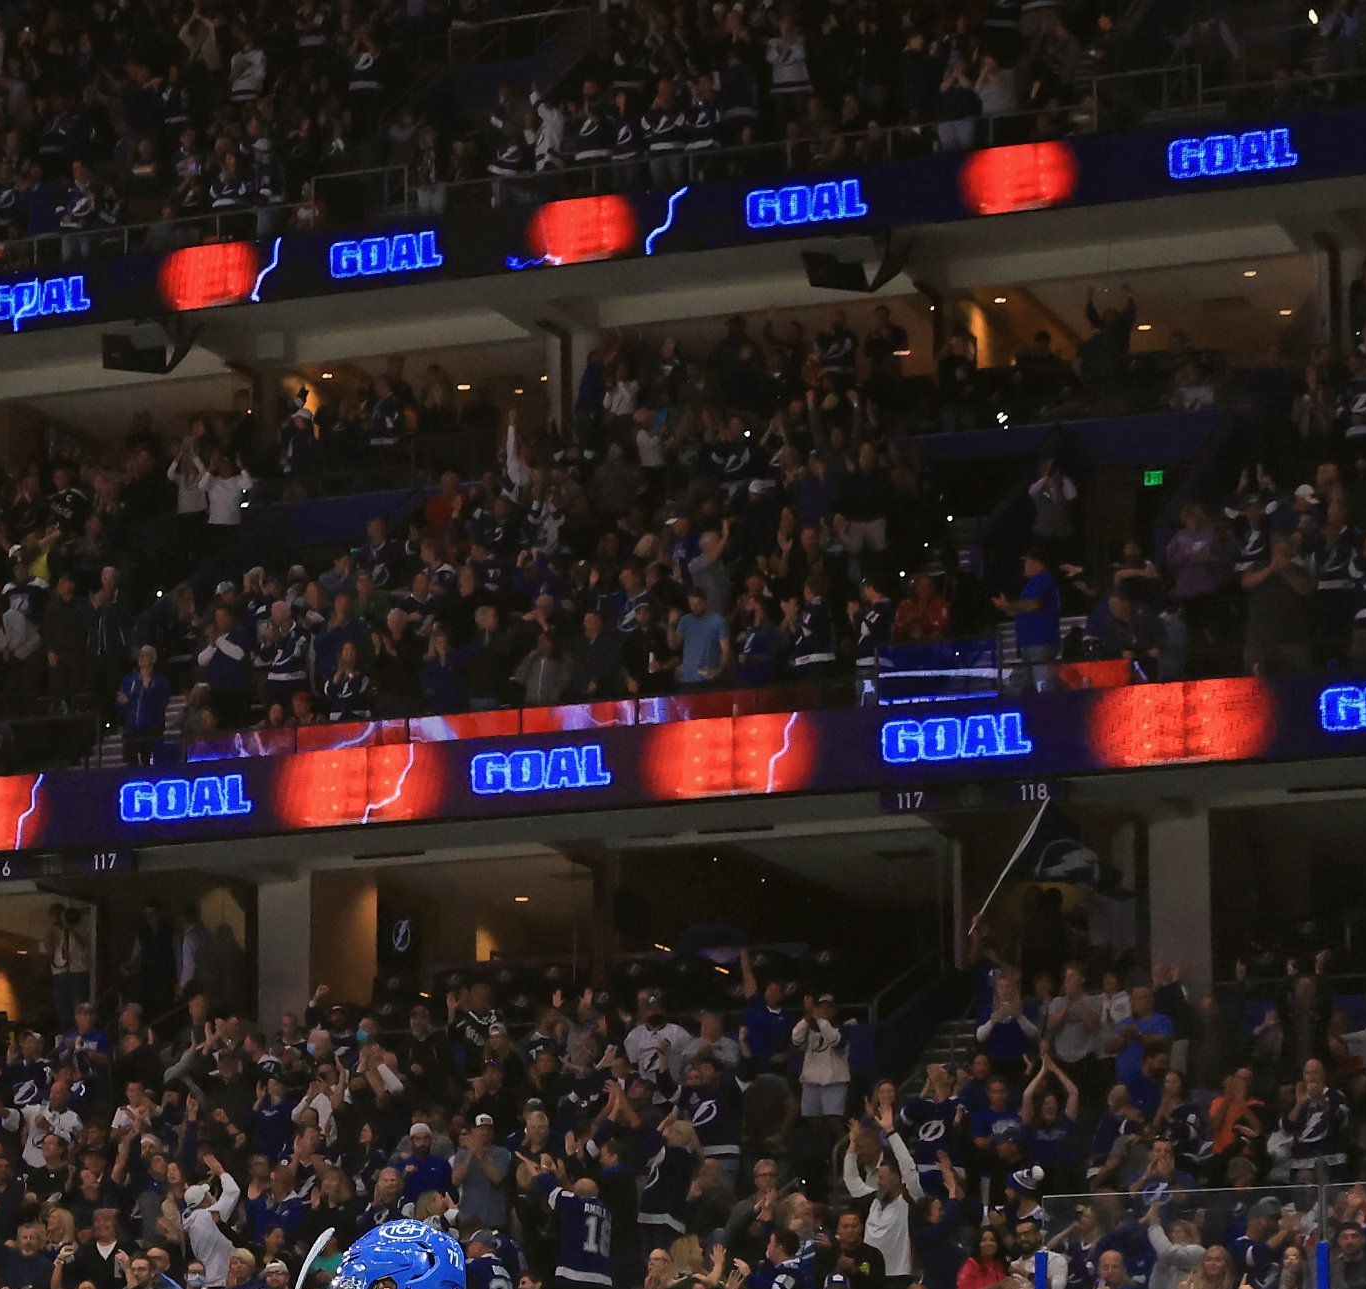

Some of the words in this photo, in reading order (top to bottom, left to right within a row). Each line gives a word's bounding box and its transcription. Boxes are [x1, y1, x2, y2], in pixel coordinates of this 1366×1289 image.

[1167, 128, 1298, 179] GOAL
[745, 178, 868, 228] GOAL
[330, 231, 443, 278] GOAL
[881, 711, 1033, 763] GOAL
[470, 744, 612, 795] GOAL
[1021, 783, 1049, 801] 118
[119, 773, 253, 822] GOAL
[898, 792, 924, 809] 117
[94, 853, 117, 871] 117
